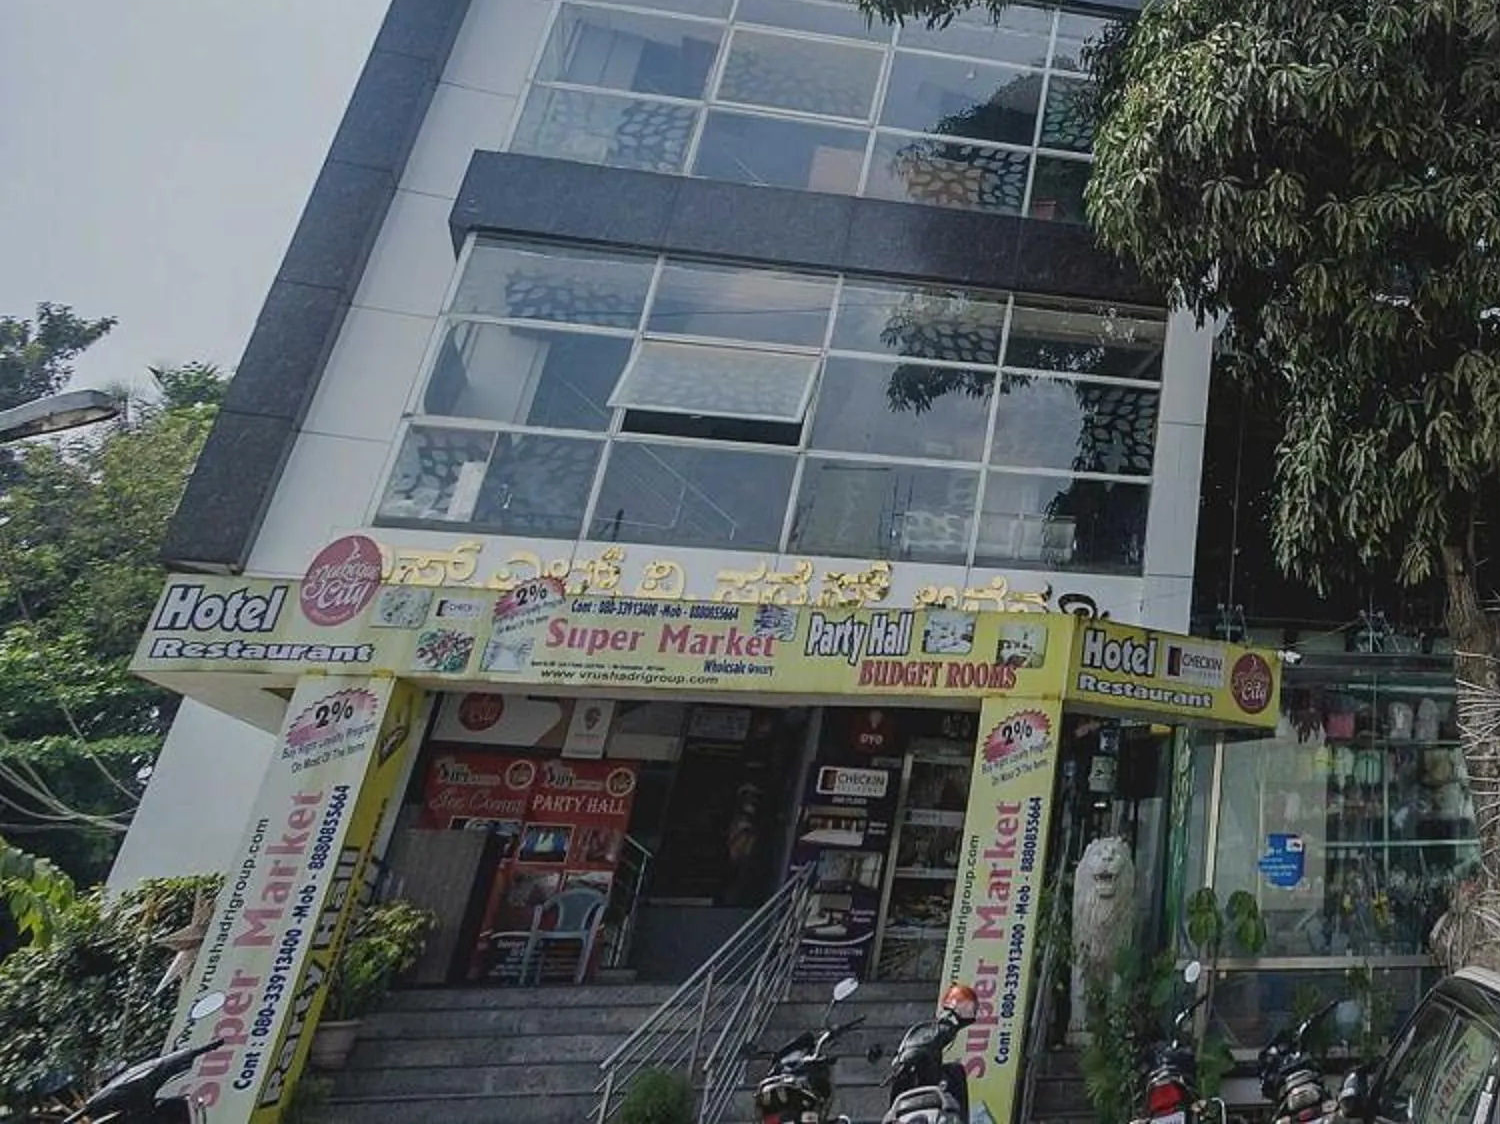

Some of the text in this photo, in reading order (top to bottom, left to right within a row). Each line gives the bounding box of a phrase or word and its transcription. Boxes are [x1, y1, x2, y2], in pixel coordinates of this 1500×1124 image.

[153, 584, 289, 632] Hotel
[316, 578, 369, 618] City
[515, 584, 548, 606] 2%
[150, 637, 375, 662] Restaurant
[545, 615, 645, 655] Super
[657, 624, 777, 658] Market
[804, 610, 915, 666] Party Hall
[1081, 628, 1159, 677] Hotel
[858, 660, 1018, 689] BUDGET ROOMS
[1077, 672, 1213, 708] Restaurant
[315, 698, 354, 728] 2%
[1002, 719, 1033, 746] 2%
[532, 794, 584, 813] PARTY
[586, 796, 625, 814] HALL
[972, 799, 1023, 941] Market
[178, 818, 270, 1045] wwvrushadrigroup.com
[951, 834, 980, 986] vrushadrigroup.com
[180, 790, 323, 1108] Super Market
[232, 1051, 262, 1090] Cont
[251, 929, 303, 1037] 080-33913400
[308, 784, 351, 870] 8880855664
[261, 962, 328, 1108] Party
[310, 846, 362, 952] Hall
[1001, 923, 1026, 1019] 080-33913400
[964, 959, 1000, 1079] Super
[994, 1032, 1012, 1065] Cont
